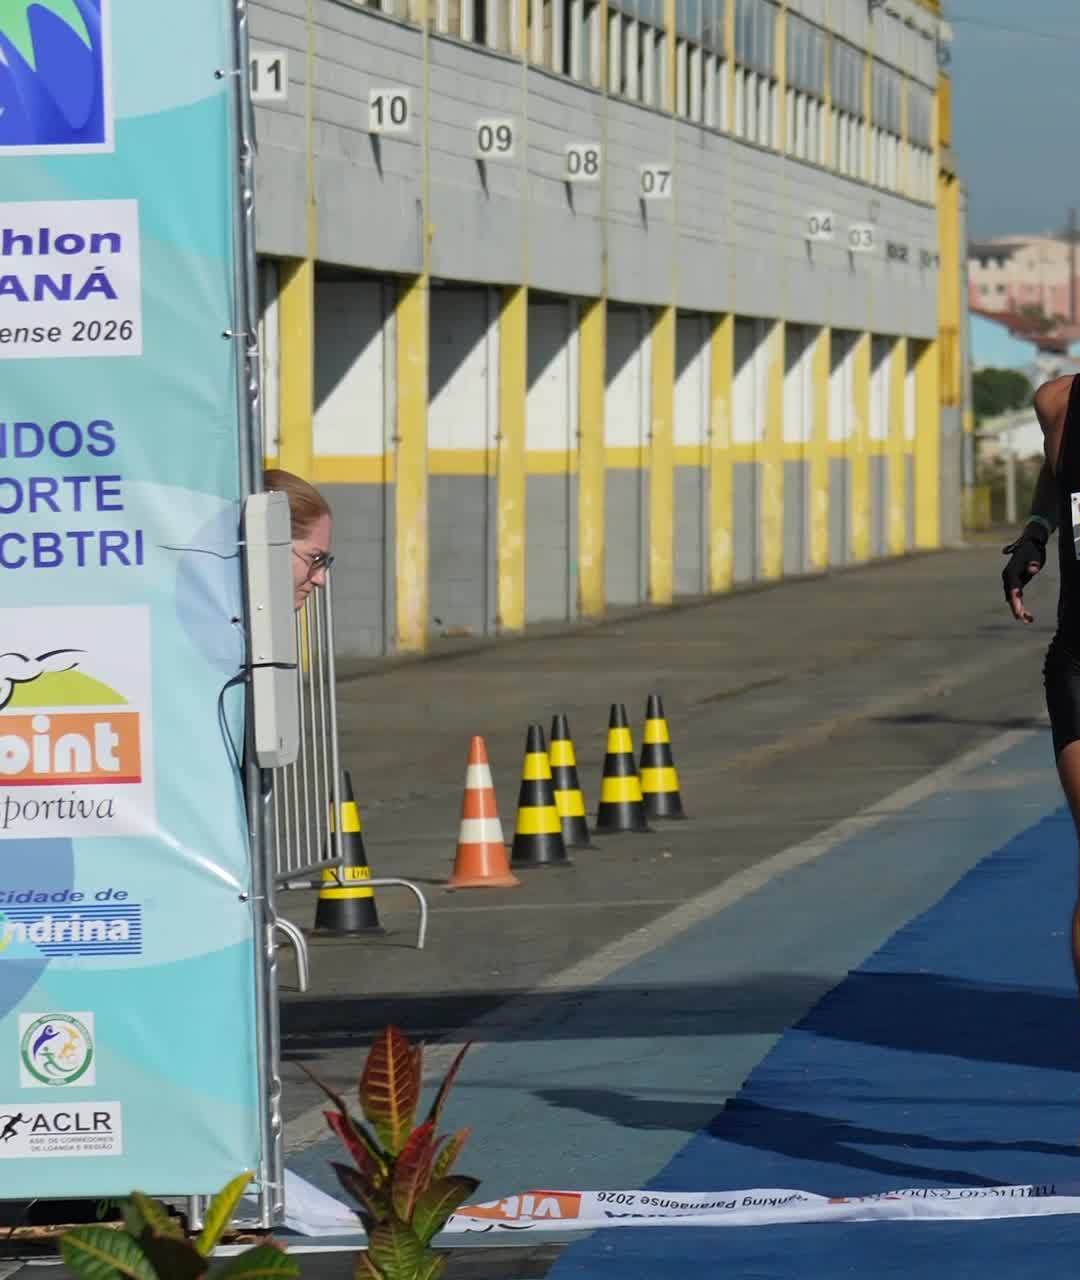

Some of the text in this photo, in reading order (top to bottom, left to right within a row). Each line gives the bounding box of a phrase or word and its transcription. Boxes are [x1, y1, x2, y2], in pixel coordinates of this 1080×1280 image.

[251, 59, 281, 92] 11
[371, 95, 408, 125] 10
[478, 125, 513, 152] 09
[567, 150, 599, 175] 08
[641, 171, 671, 193] 07
[808, 216, 832, 235] 04
[2, 228, 122, 256] hlon
[850, 230, 873, 247] 03
[0, 266, 118, 302] ANÁ
[0, 319, 134, 344] ense 2026
[0, 475, 125, 514] ORTE
[0, 529, 144, 569] CBTRI
[1, 791, 115, 829] portiva
[95, 888, 129, 901] de
[32, 1111, 112, 1132] ACLR
[596, 1191, 636, 1206] 2026
[640, 1194, 736, 1210] Paranaense
